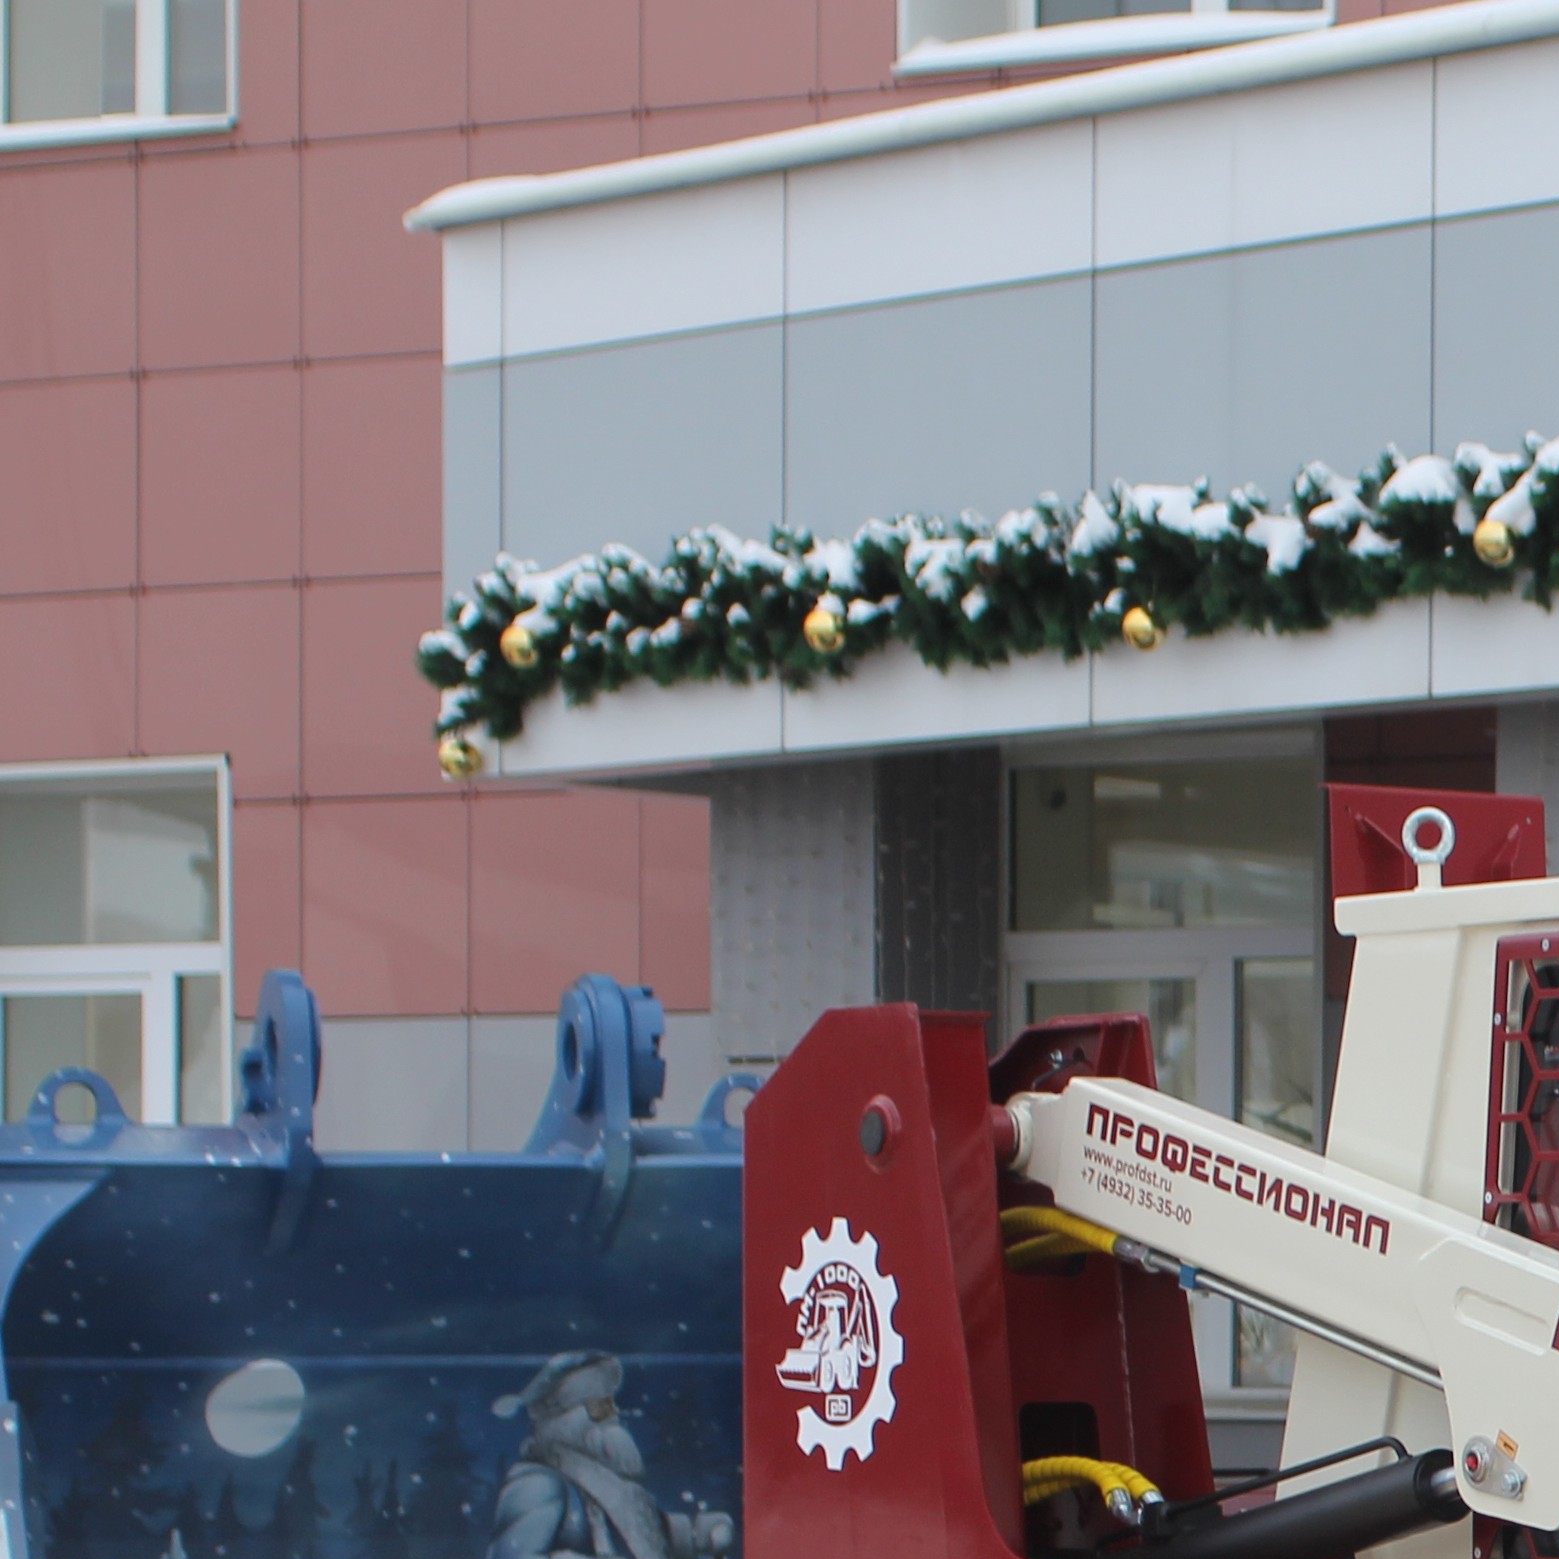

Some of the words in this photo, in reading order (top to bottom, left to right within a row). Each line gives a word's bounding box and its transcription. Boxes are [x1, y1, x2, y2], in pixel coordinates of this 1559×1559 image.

[1081, 1166, 1096, 1185] +7
[1096, 1173, 1136, 1206] (4932)
[1137, 1188, 1193, 1226] 35-35-00
[1082, 1145, 1173, 1193] www.profdst.ru
[1086, 1102, 1390, 1256] ПРОФЕССИОНАЛ
